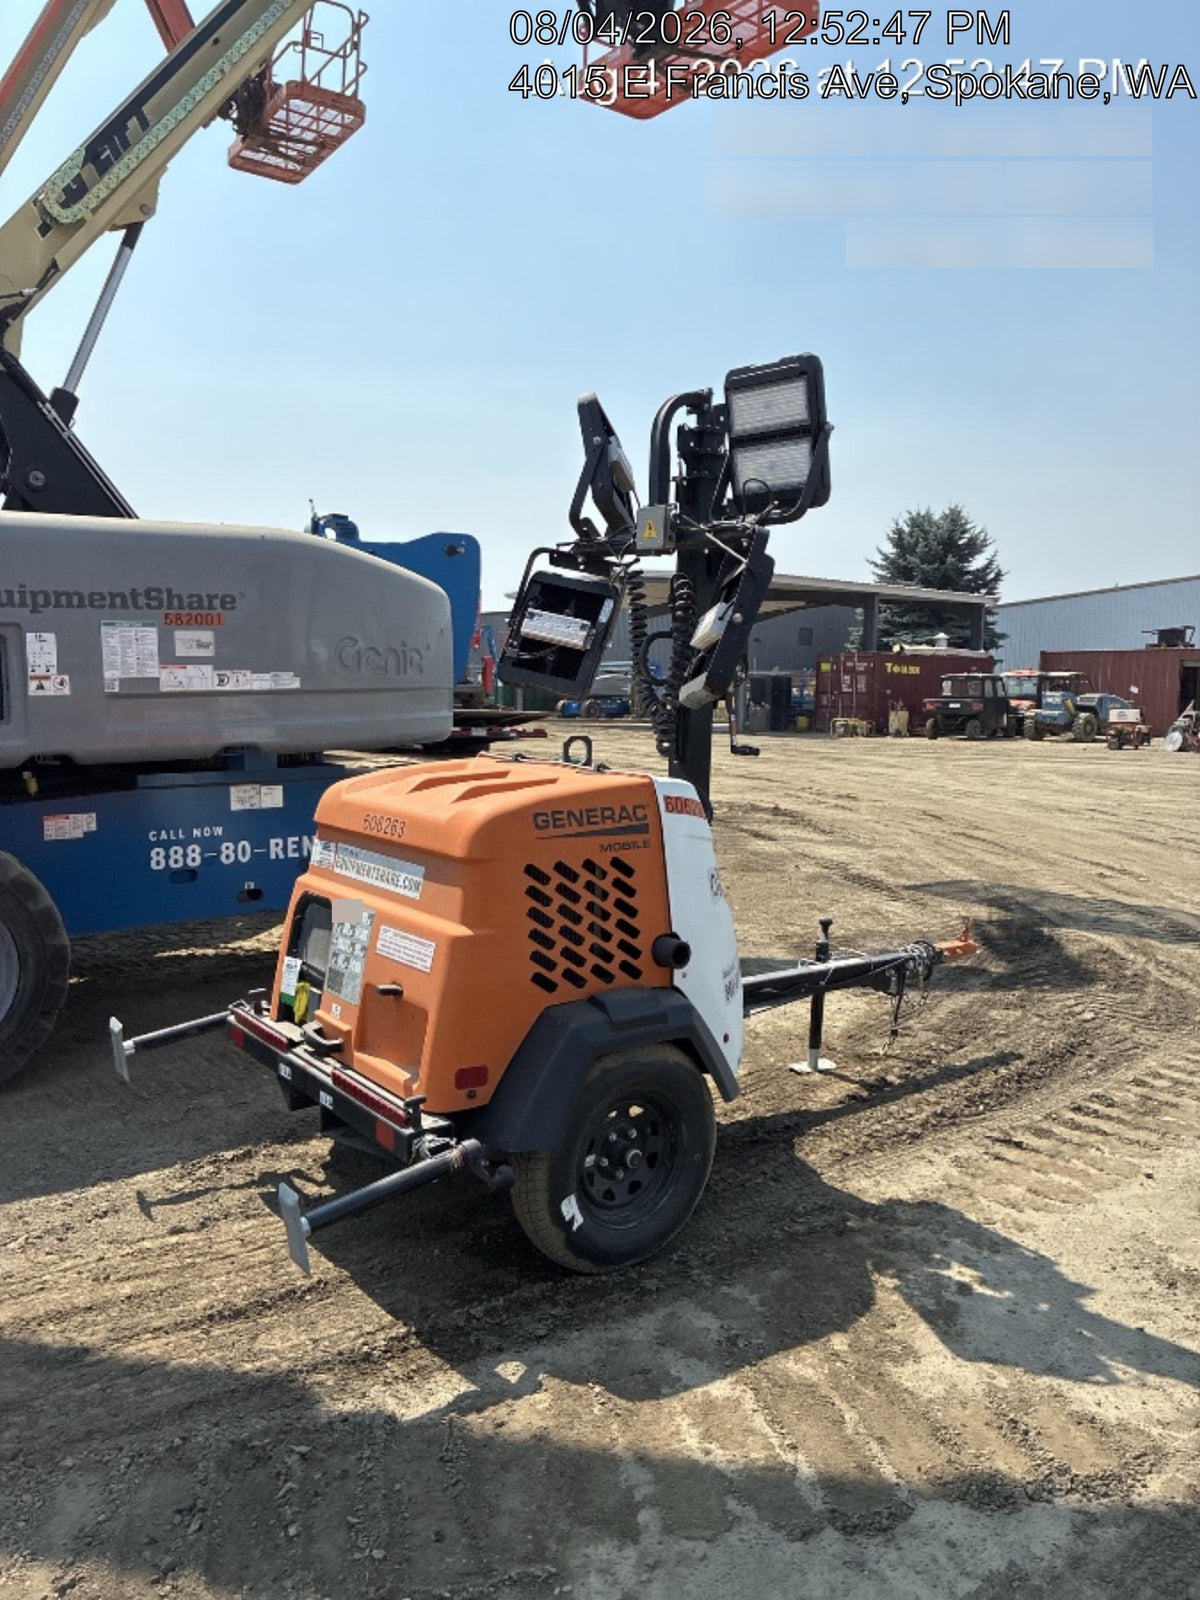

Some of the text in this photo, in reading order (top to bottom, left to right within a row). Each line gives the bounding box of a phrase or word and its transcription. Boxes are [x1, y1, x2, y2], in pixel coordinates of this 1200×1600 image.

[164, 613, 223, 626] 582001
[532, 804, 649, 831] GENERAC
[148, 826, 224, 841] CALL NOW
[599, 839, 651, 853] MOBILE
